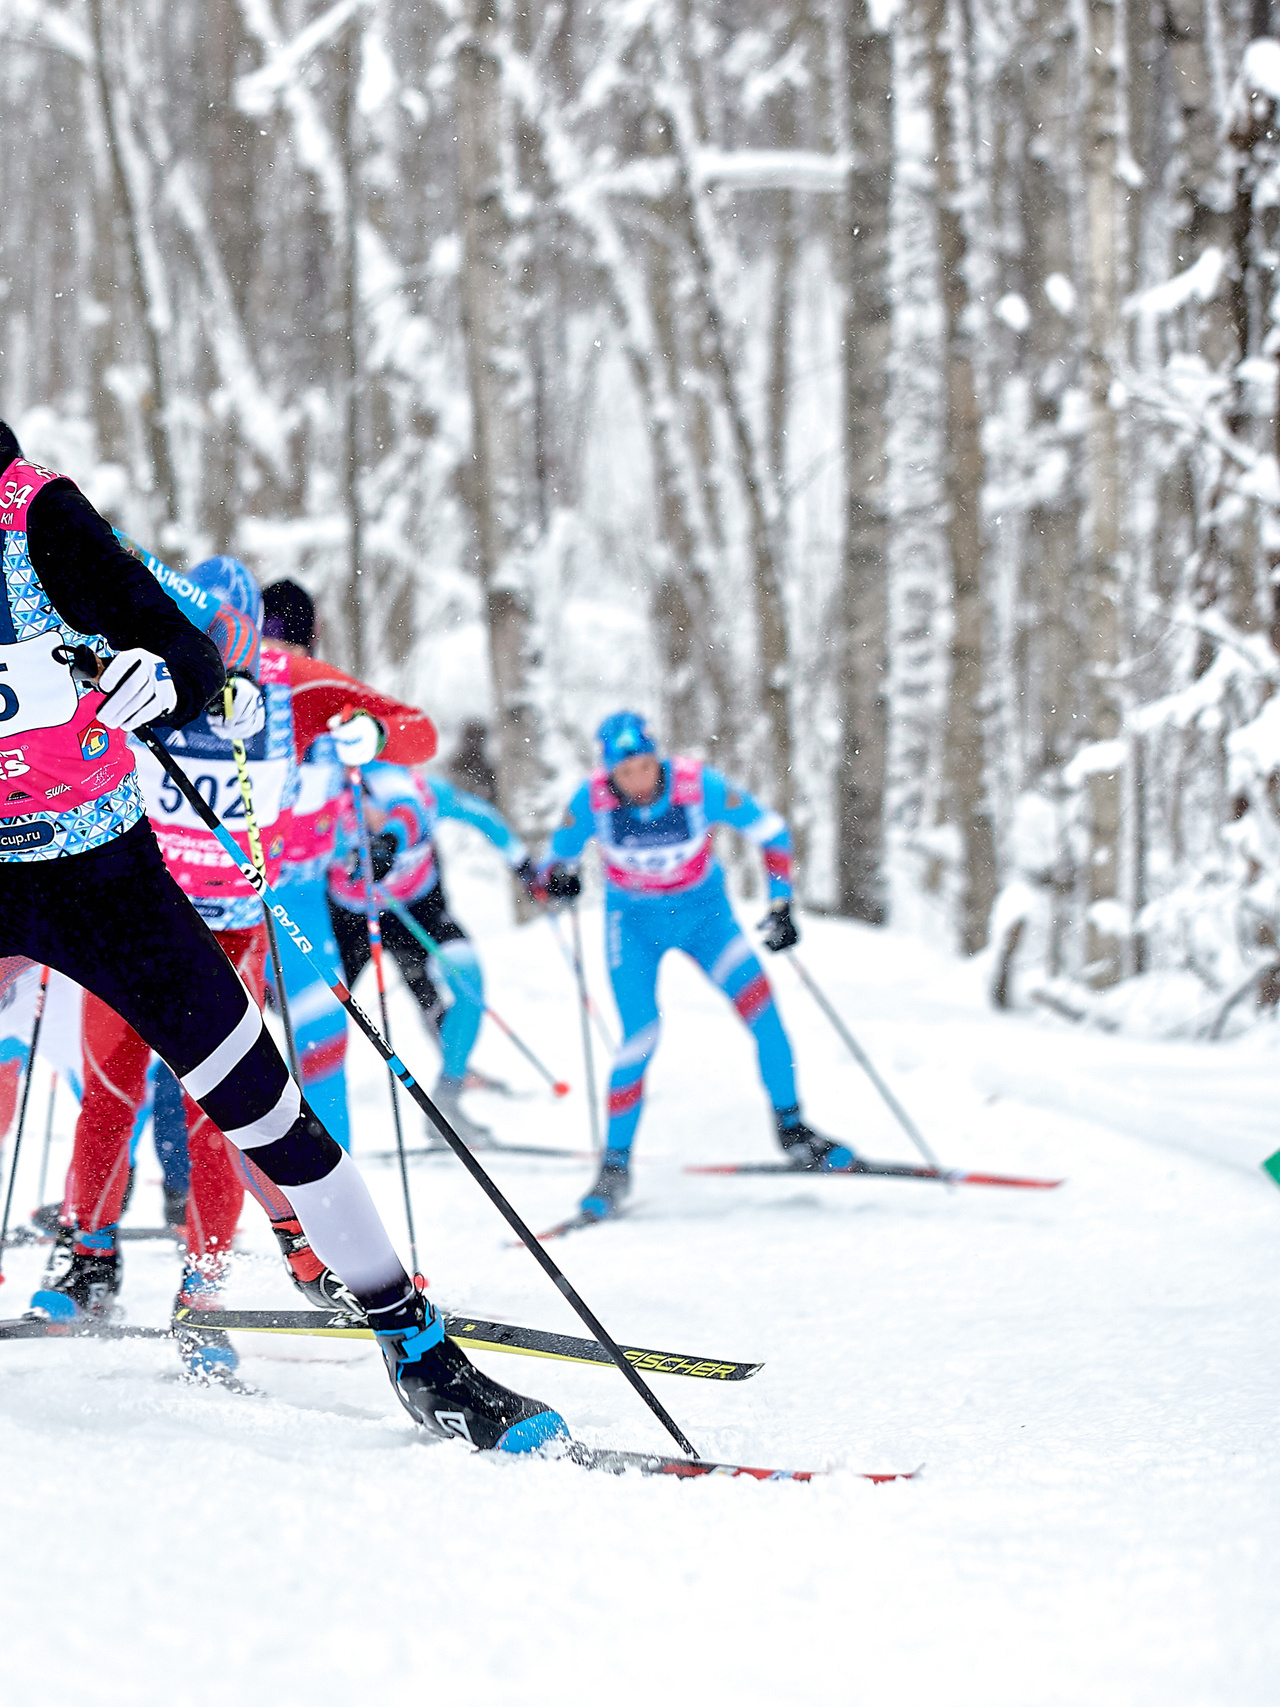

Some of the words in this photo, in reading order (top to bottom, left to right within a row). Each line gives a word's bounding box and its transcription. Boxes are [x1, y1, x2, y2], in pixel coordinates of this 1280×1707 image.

[147, 556, 208, 610] LUKOIL
[159, 770, 254, 819] 502
[623, 1350, 737, 1379] FISCHER
